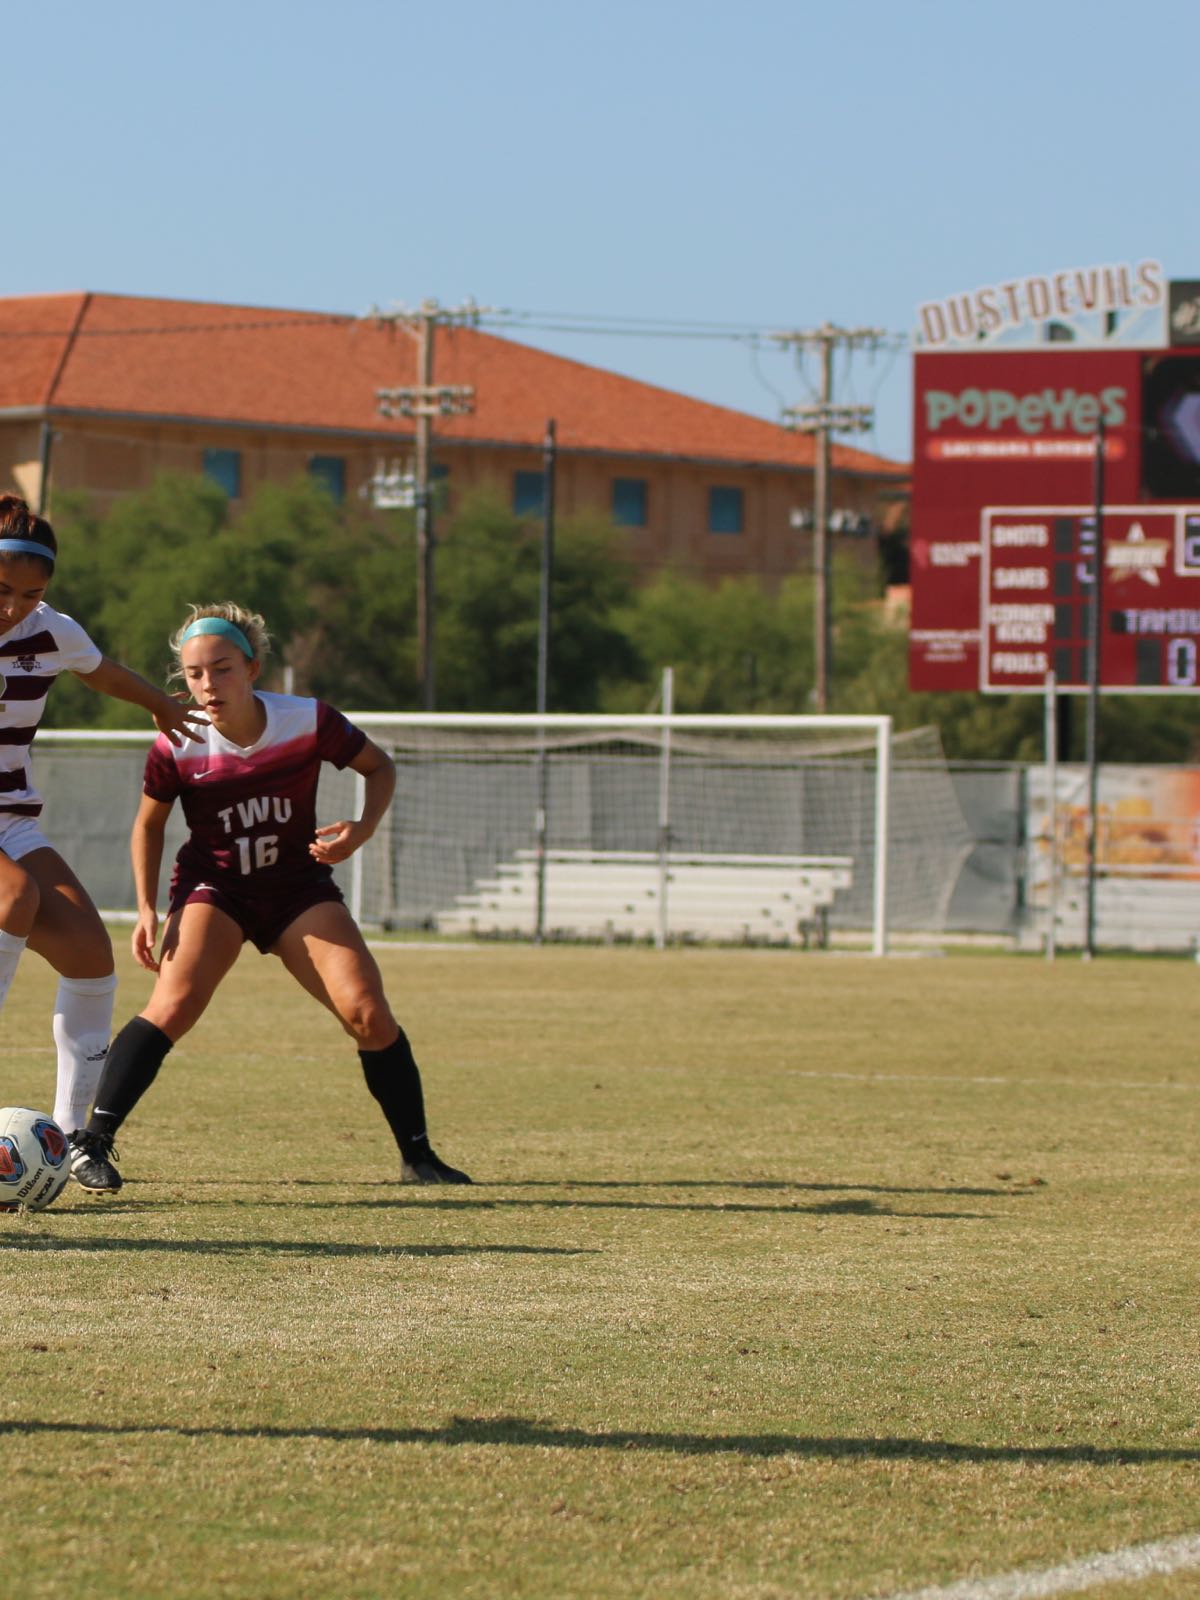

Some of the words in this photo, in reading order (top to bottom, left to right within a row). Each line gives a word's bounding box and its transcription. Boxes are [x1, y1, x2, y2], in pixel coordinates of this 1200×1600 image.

[920, 261, 1161, 345] DUSTDEVILS
[1167, 638, 1197, 687] 0
[217, 796, 293, 834] TWU
[235, 835, 280, 876] 16
[17, 1168, 45, 1198] Wilson
